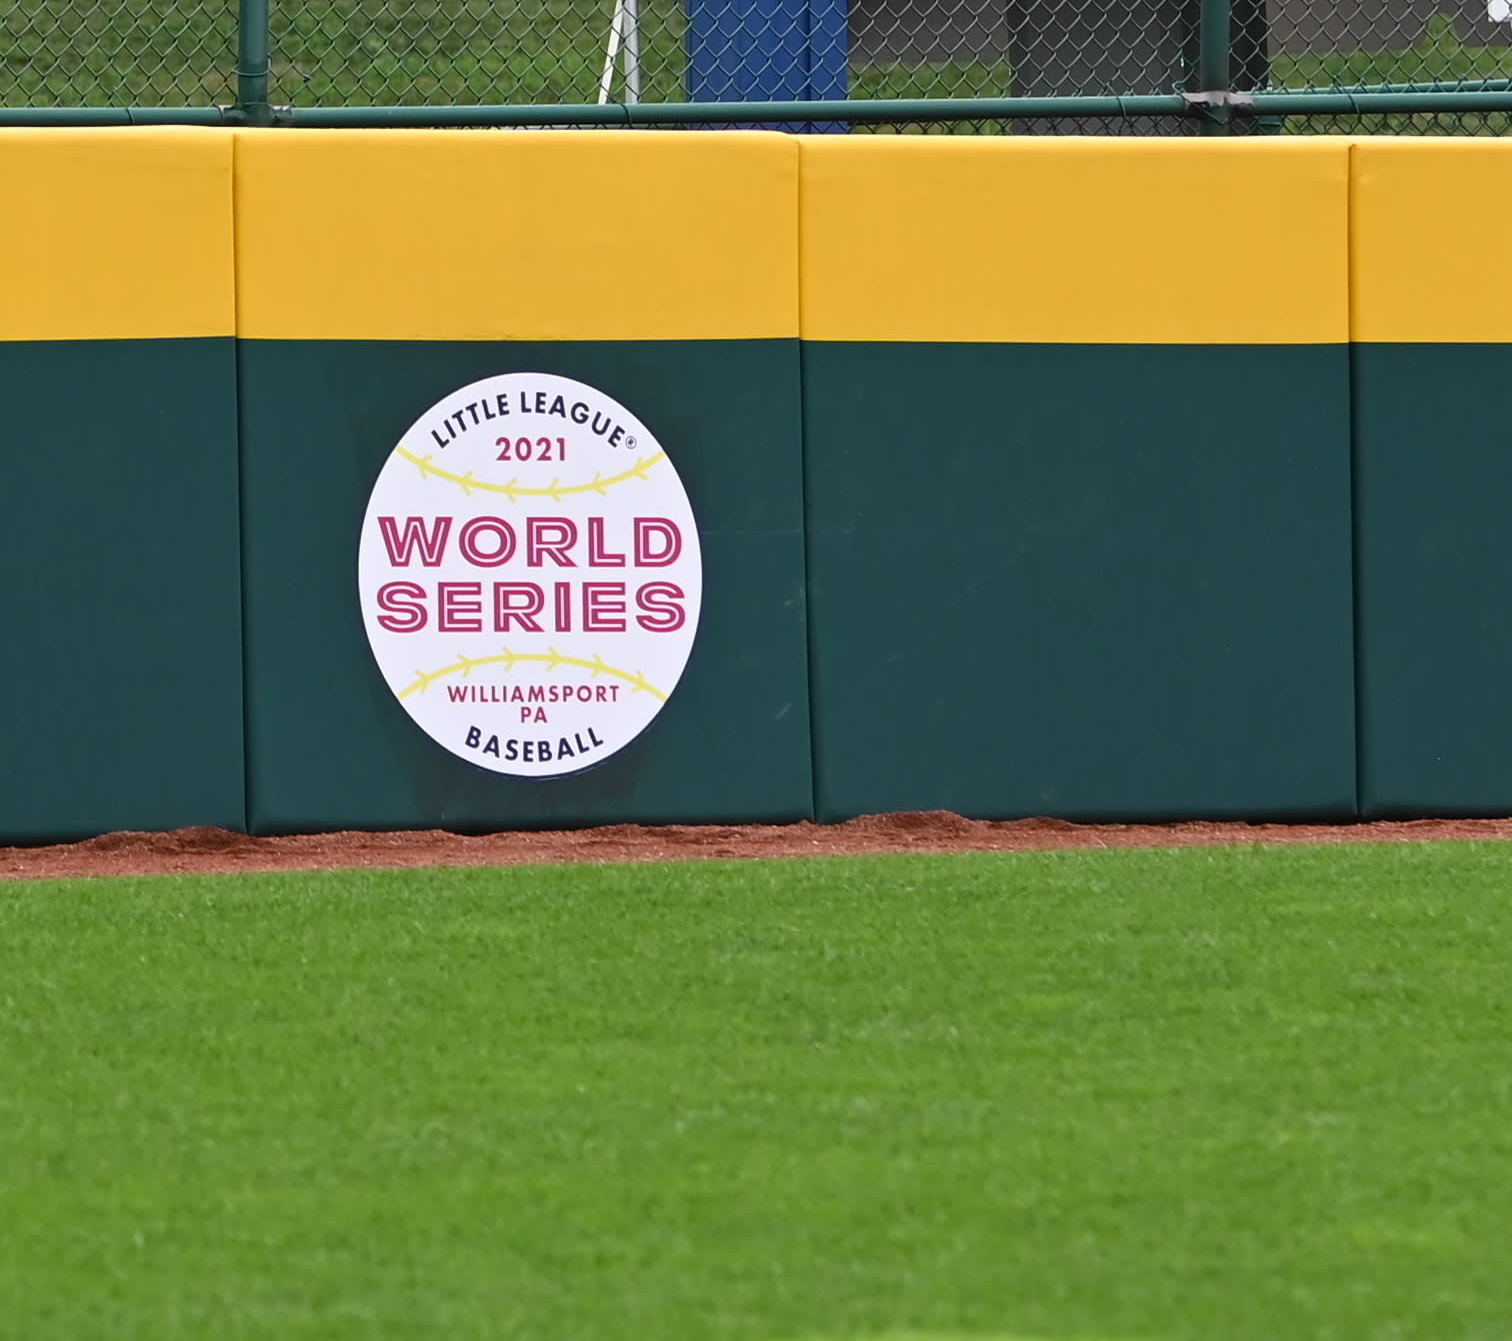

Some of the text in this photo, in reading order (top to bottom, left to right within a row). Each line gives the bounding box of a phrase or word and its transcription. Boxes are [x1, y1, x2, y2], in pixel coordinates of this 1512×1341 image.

[431, 393, 510, 449] LITTLE
[495, 437, 566, 461] 2021
[377, 516, 683, 567] WORLD
[378, 581, 686, 633] SERIES
[447, 685, 620, 703] WILLIAMSPORT
[520, 706, 548, 724] PA
[464, 725, 604, 762] BASEBALL
